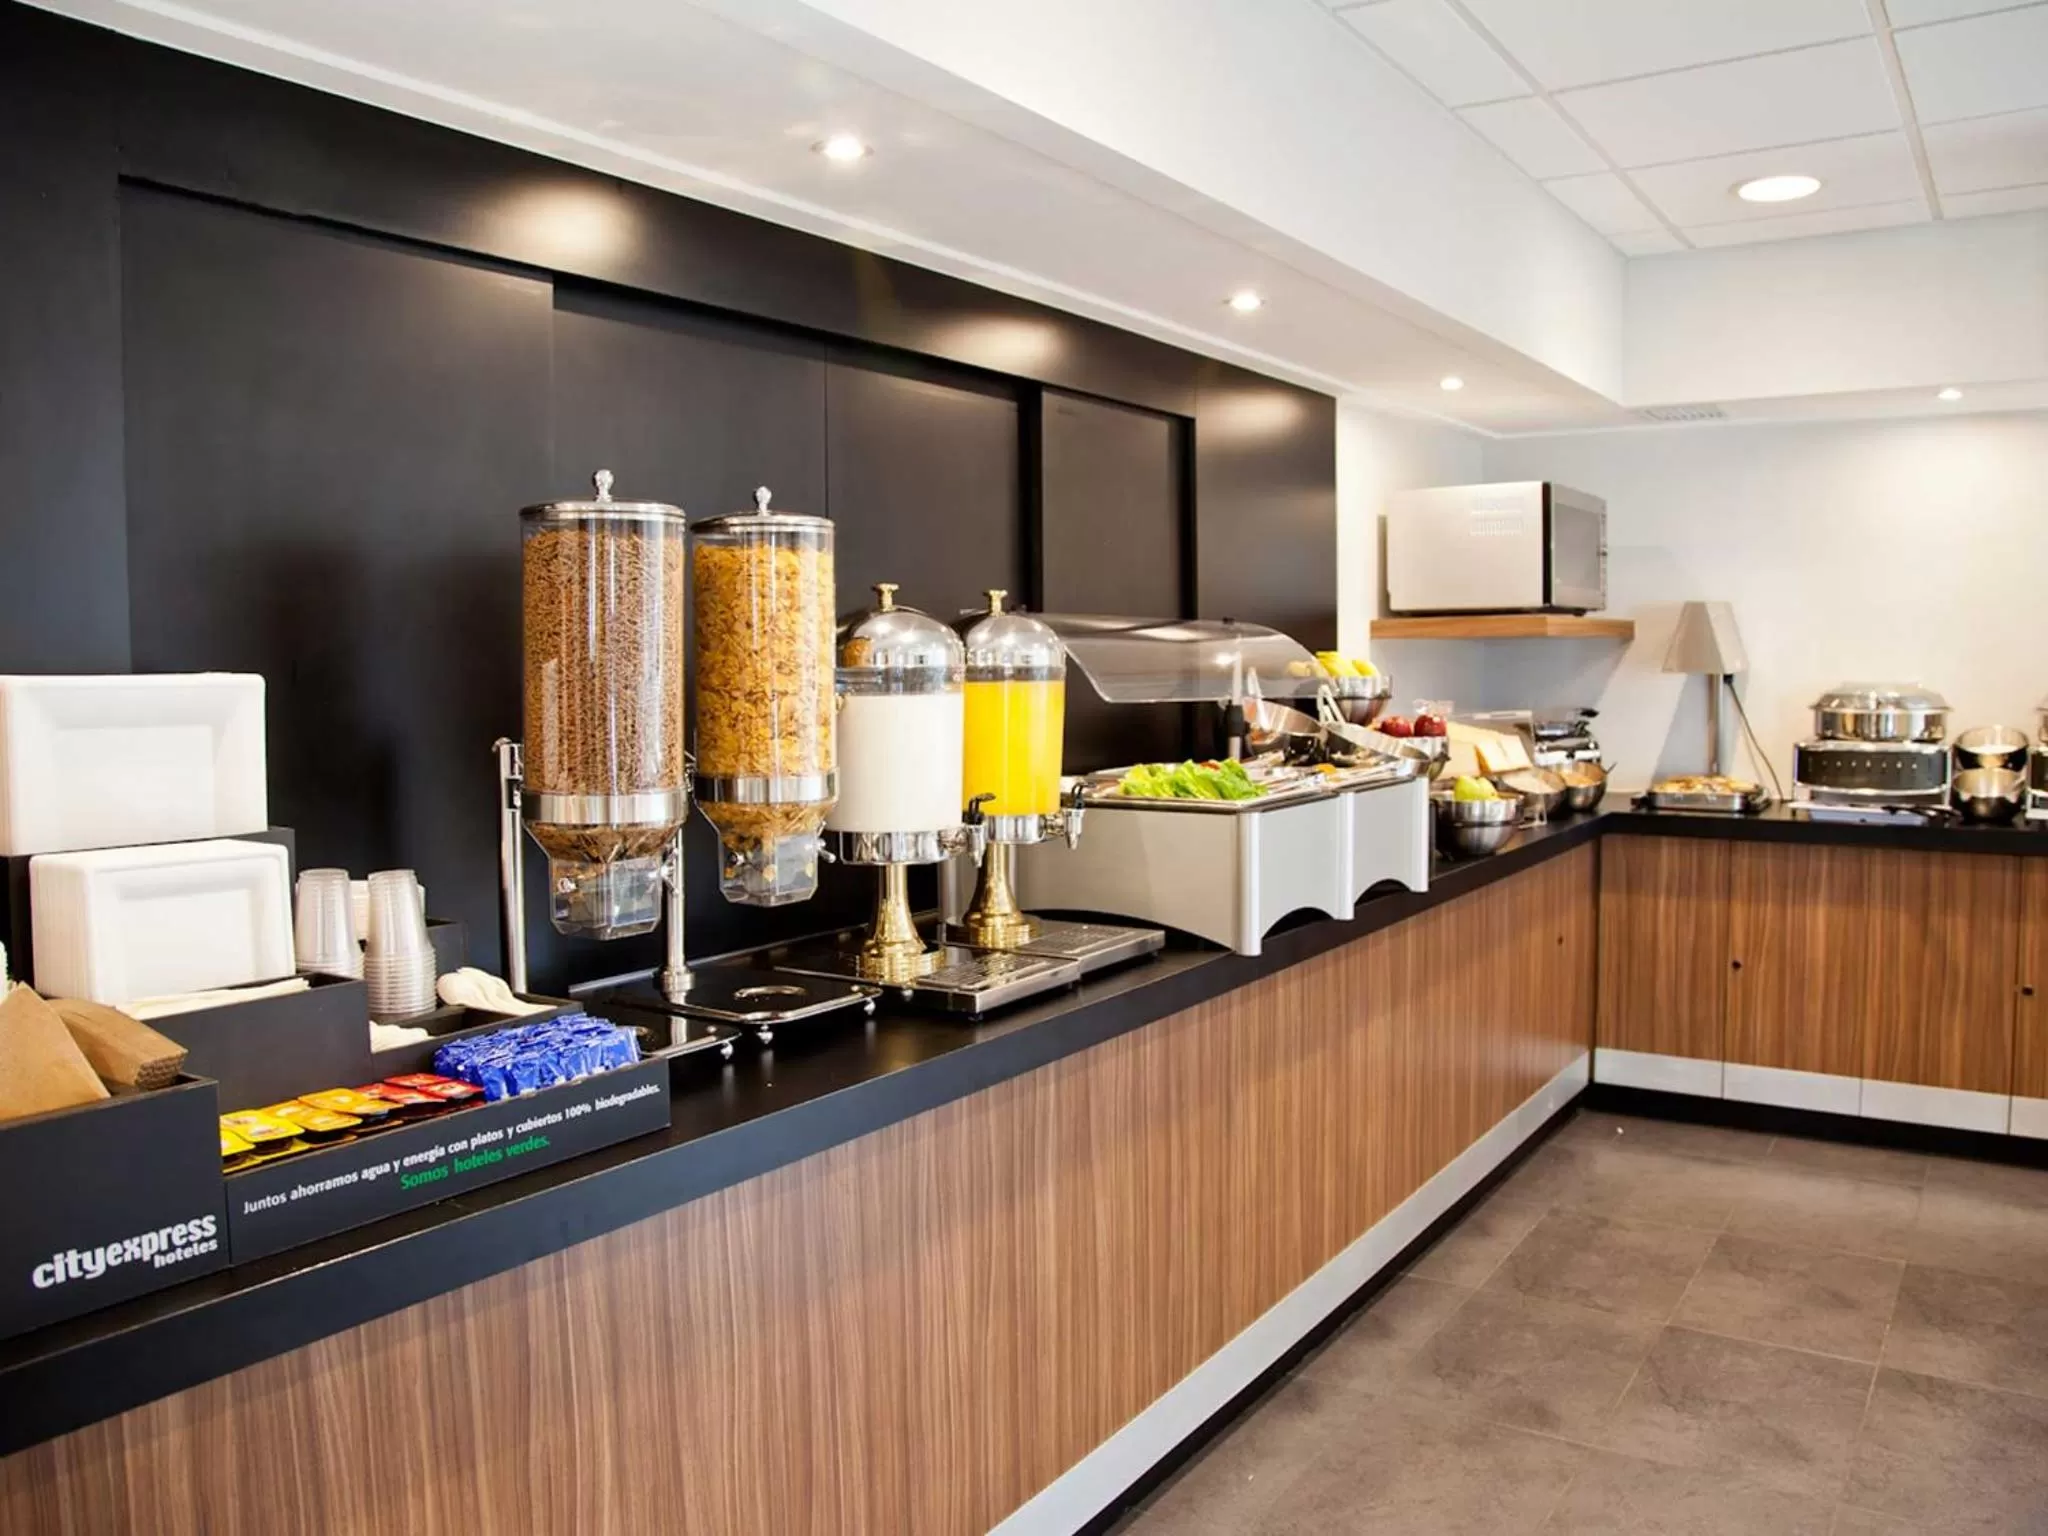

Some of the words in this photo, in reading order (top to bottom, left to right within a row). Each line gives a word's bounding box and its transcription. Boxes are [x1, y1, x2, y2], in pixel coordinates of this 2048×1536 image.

[243, 1192, 288, 1215] Juntos
[289, 1171, 359, 1201] ahorramos
[360, 1162, 391, 1181] agua
[392, 1159, 401, 1174] y
[447, 1139, 469, 1154] con
[469, 1128, 505, 1151] platos
[506, 1125, 515, 1140] y
[515, 1111, 564, 1134] cubiertos
[564, 1102, 593, 1120] 100%
[594, 1083, 661, 1112] biodegradables.
[400, 1166, 449, 1189] Somos
[454, 1149, 503, 1173] hoteles
[505, 1135, 550, 1157] verdes.
[32, 1214, 217, 1289] cityexpress
[153, 1239, 218, 1269] hoteles
